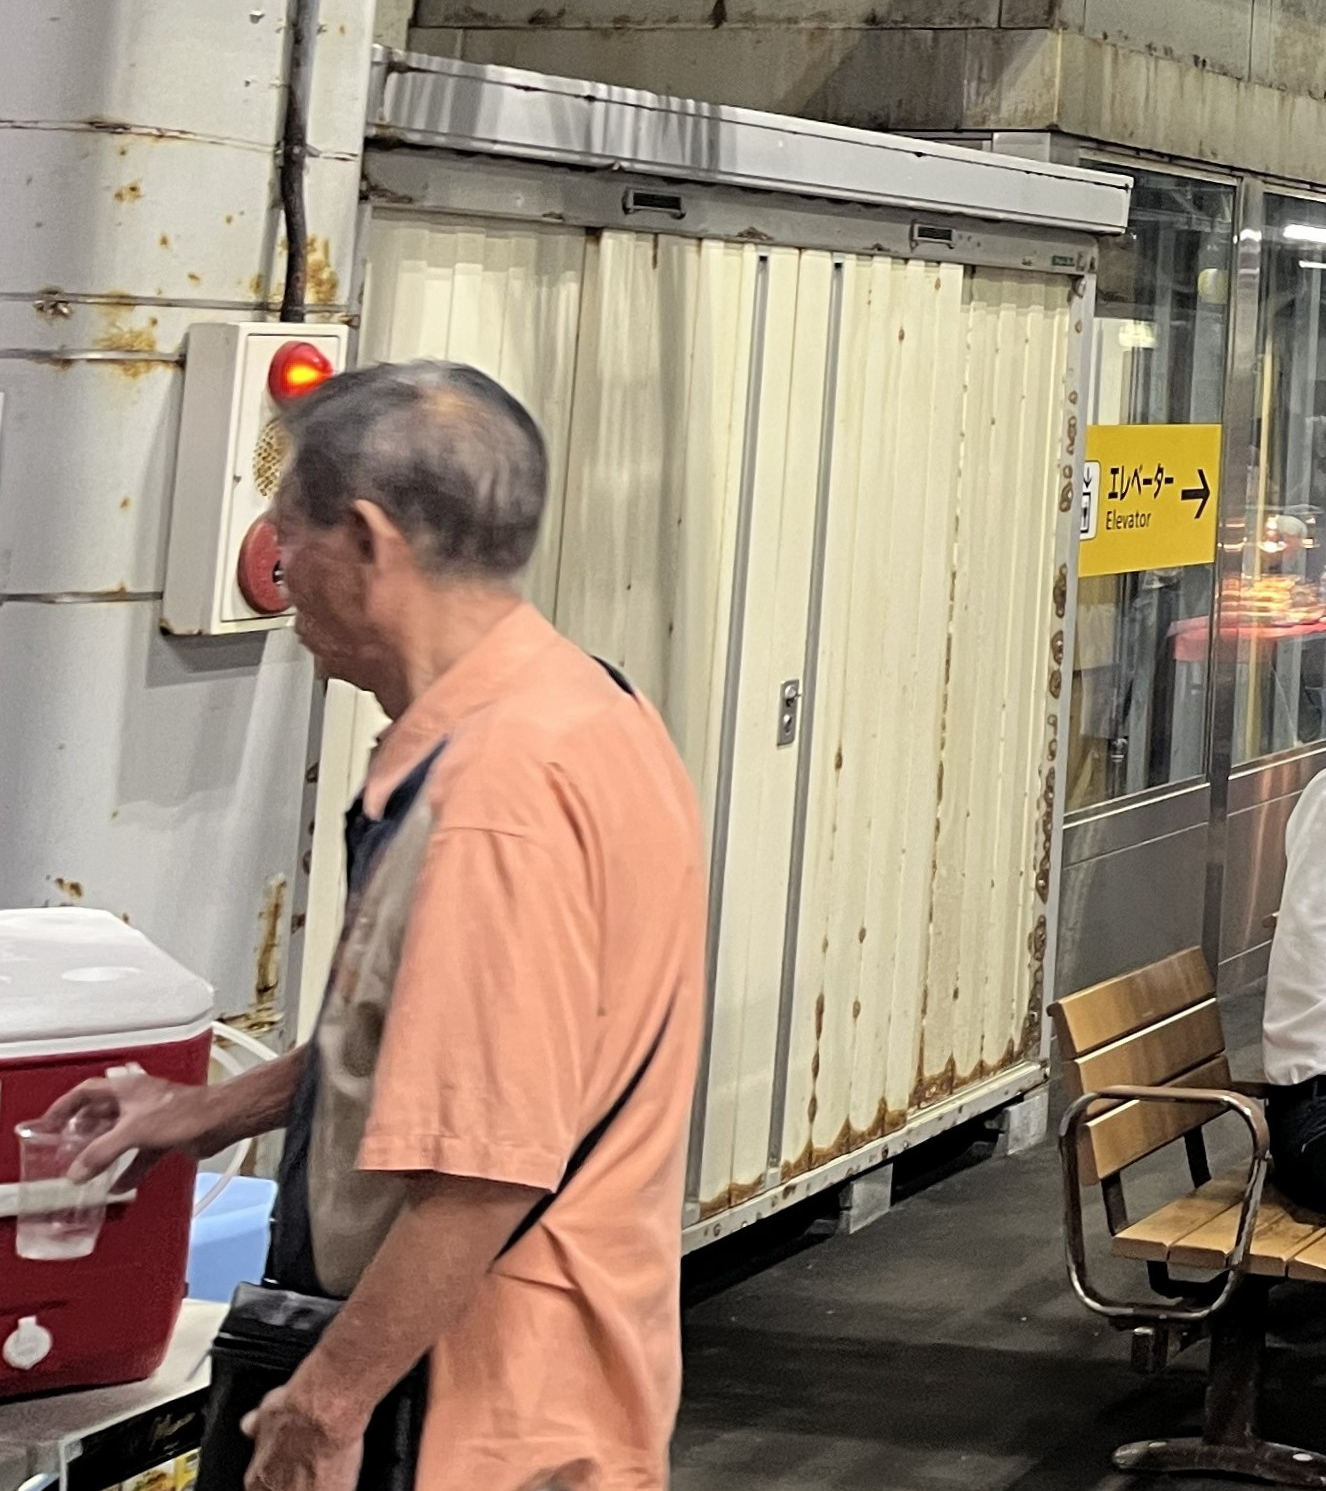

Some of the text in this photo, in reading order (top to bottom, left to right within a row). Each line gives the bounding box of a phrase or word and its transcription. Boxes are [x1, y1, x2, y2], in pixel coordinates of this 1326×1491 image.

[1108, 463, 1174, 501] エレベーター
[1105, 509, 1152, 530] Elevator
